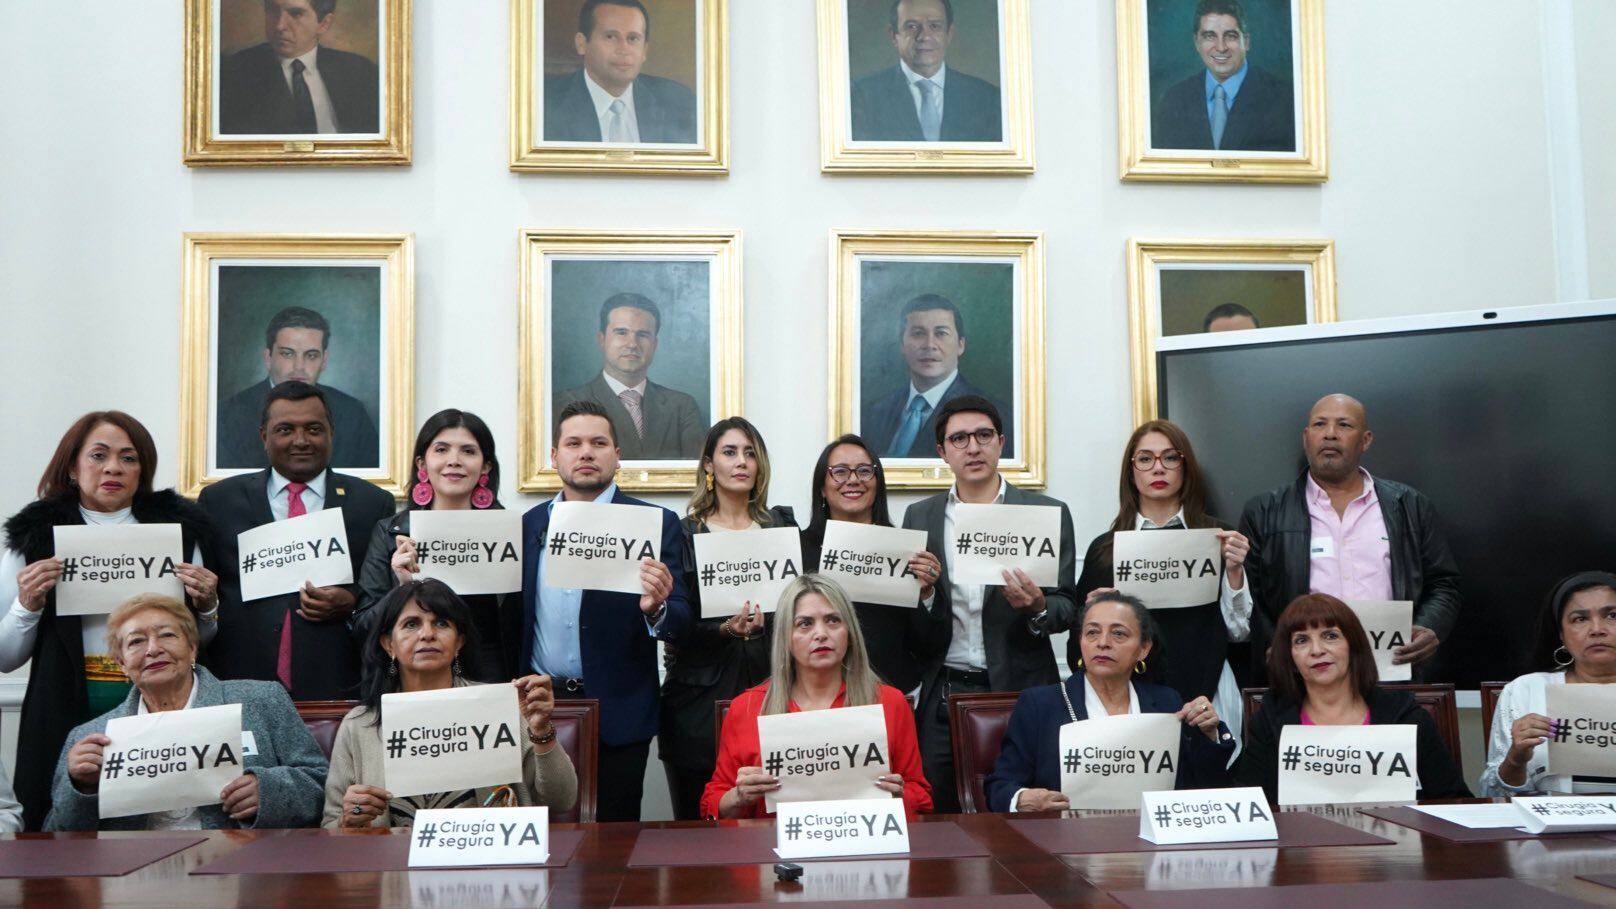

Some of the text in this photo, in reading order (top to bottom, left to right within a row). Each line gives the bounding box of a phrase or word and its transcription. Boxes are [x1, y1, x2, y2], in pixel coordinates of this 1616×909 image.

[260, 537, 345, 569] segura YA
[432, 542, 518, 566] segura YA
[569, 537, 656, 561] segura YA
[974, 537, 1055, 559] segura YA
[81, 557, 178, 582] segura YA
[718, 558, 798, 586] segura YA
[839, 563, 882, 576] segura
[1134, 558, 1217, 582] segura YA
[1370, 631, 1405, 649] YA
[411, 723, 516, 757] segura YA
[127, 742, 238, 778] segura YA
[787, 742, 884, 776] segura YA
[1085, 750, 1174, 776] segura YA
[1304, 751, 1410, 777] segura YA
[806, 814, 903, 841] segura YA
[1176, 813, 1226, 828] segura
[1225, 801, 1269, 823] YA
[439, 823, 540, 849] segura YA
